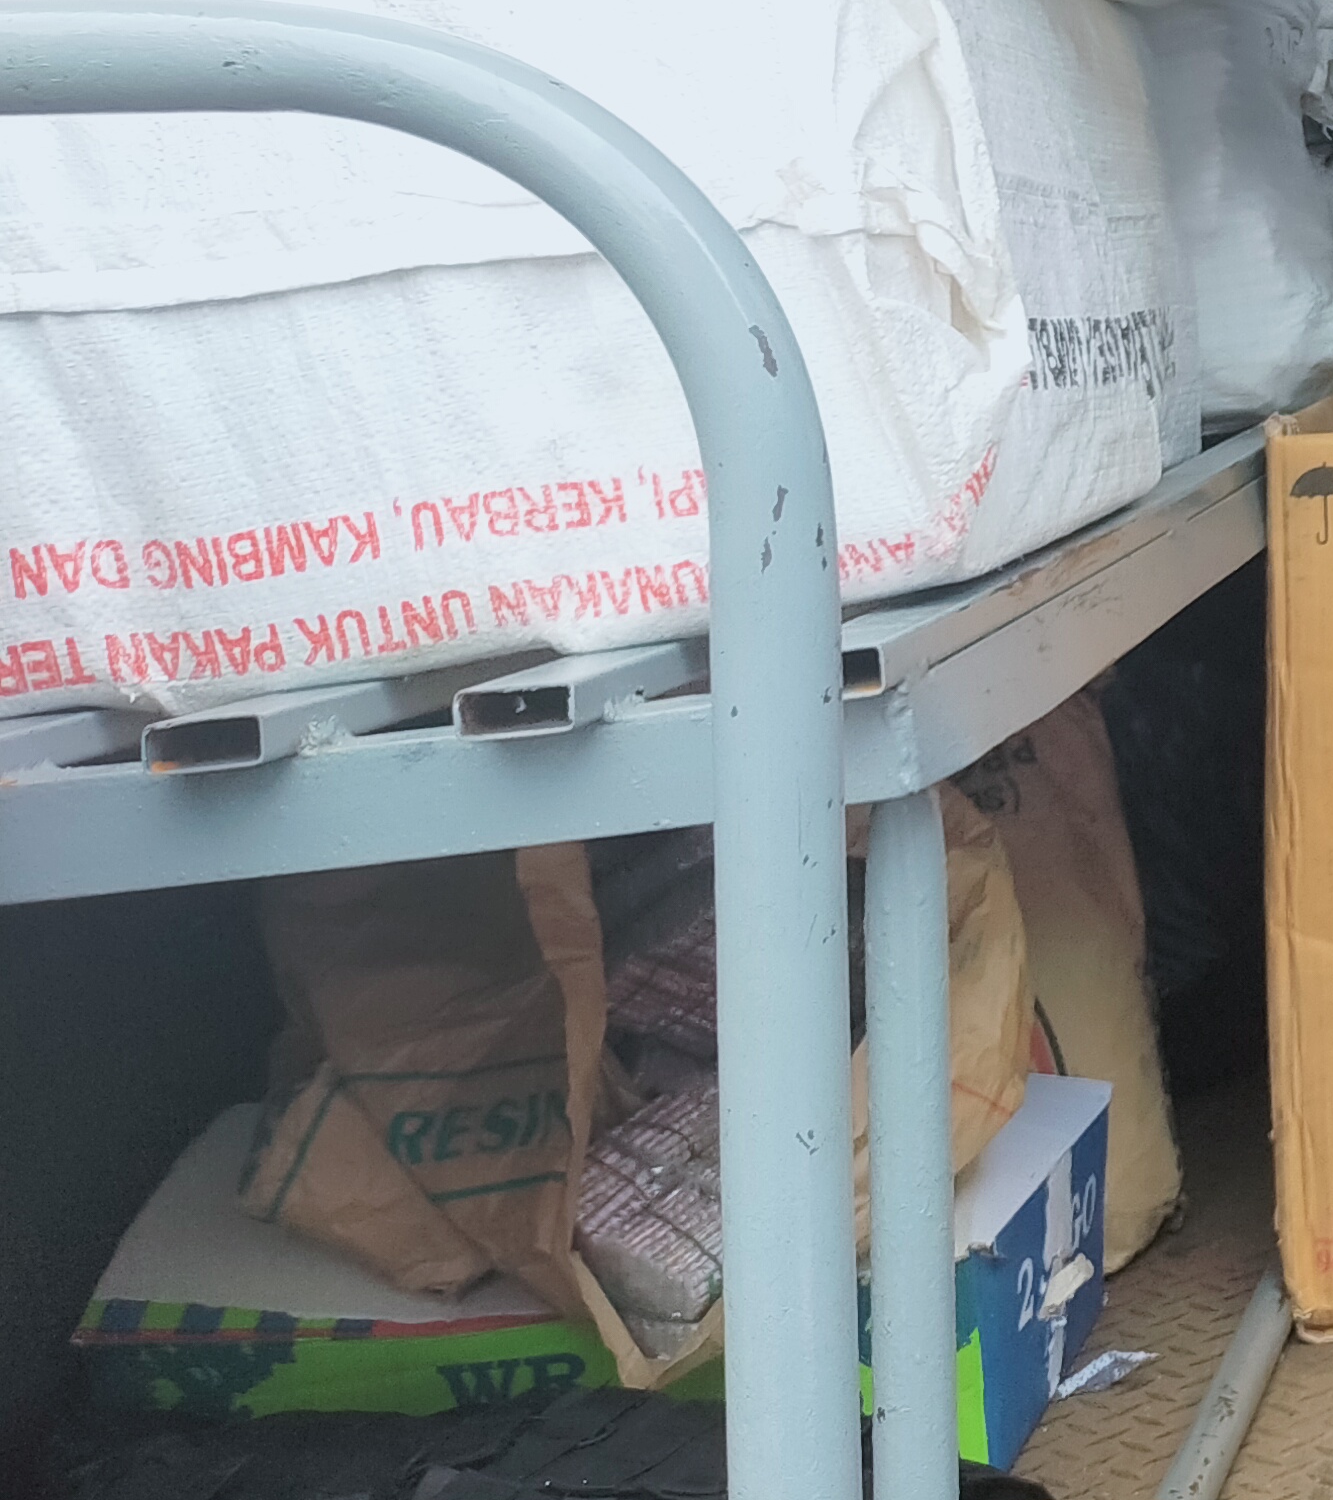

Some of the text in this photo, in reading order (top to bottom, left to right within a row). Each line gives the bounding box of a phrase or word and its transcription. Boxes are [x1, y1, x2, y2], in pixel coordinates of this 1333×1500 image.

[141, 510, 382, 592] KAMBING
[391, 475, 628, 553] KERBAU,
[8, 539, 129, 601] DAN
[105, 626, 289, 685] PAKAN
[302, 587, 479, 667] UNTUK
